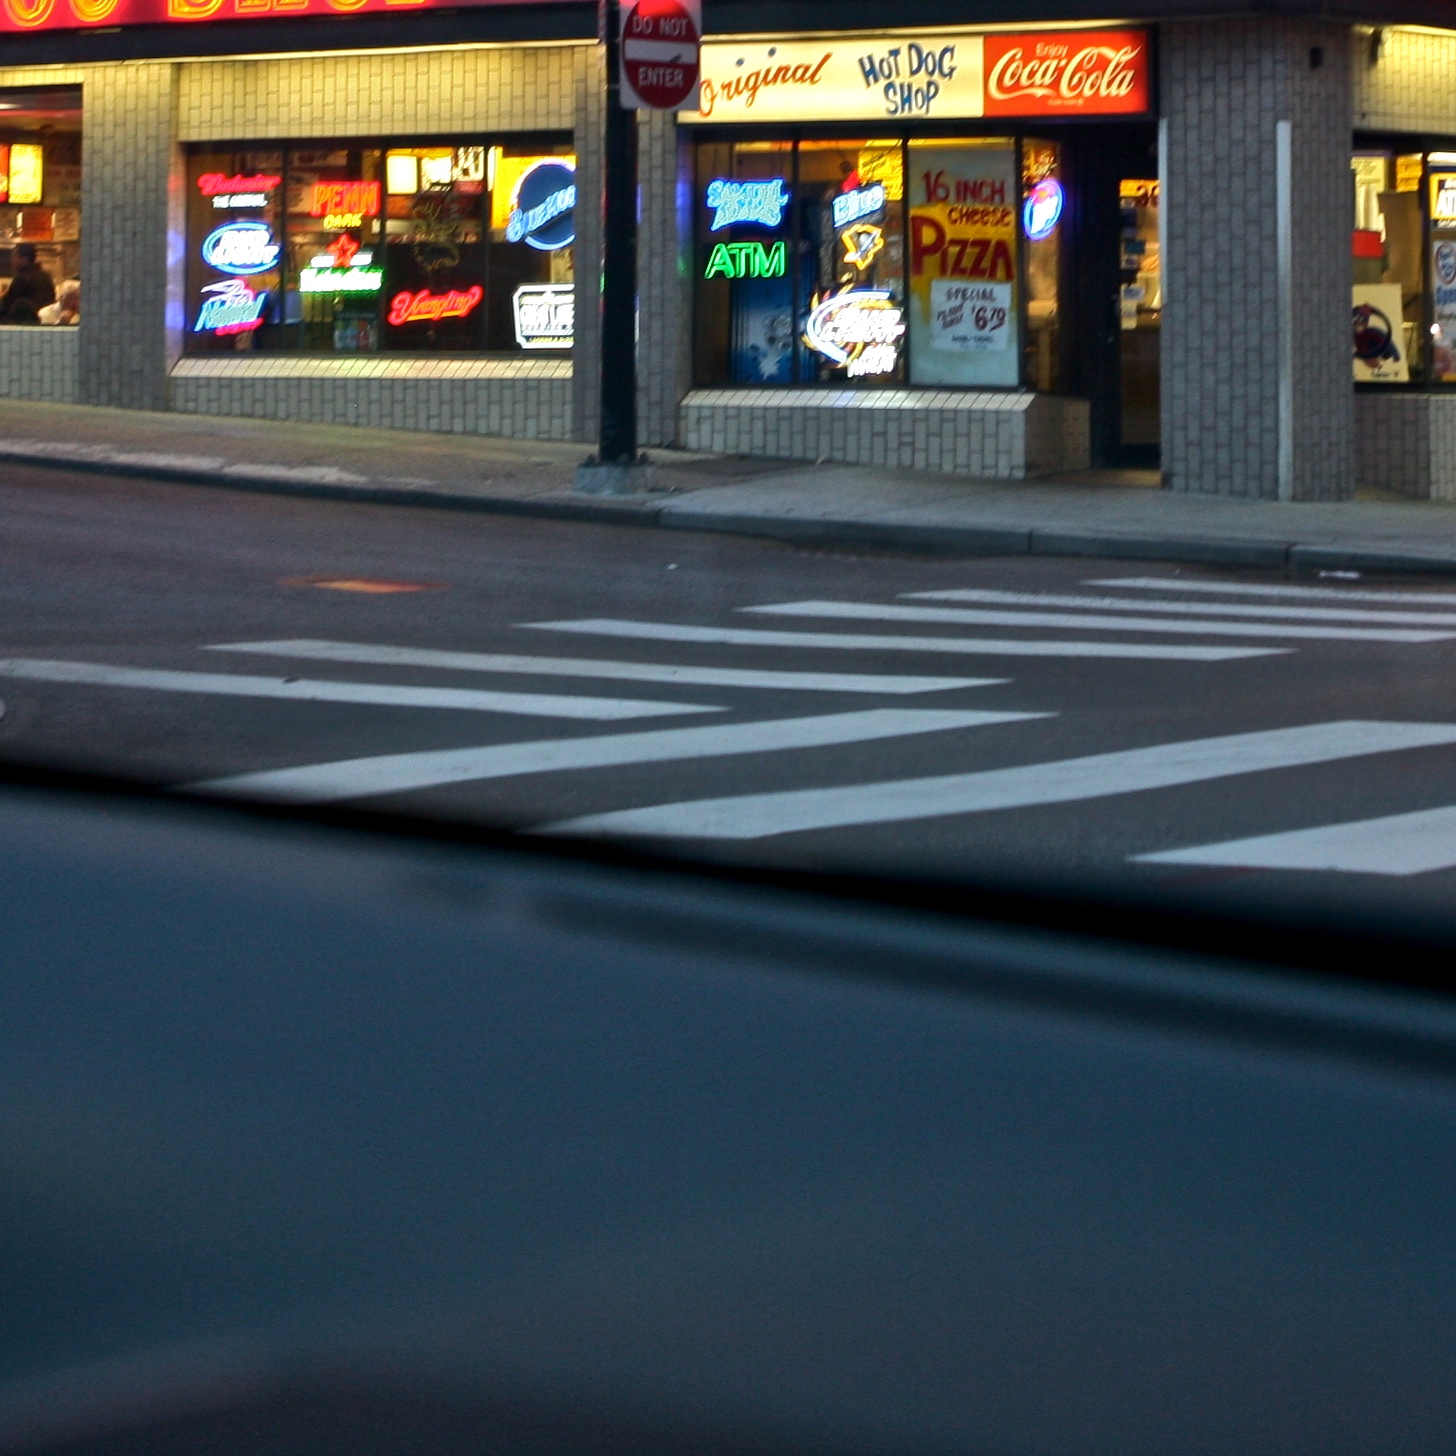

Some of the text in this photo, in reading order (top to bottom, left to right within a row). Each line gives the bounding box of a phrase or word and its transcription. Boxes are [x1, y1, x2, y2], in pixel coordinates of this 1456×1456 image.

[632, 15, 688, 36] DO NOT
[1036, 42, 1068, 60] Enjoy
[638, 66, 684, 88] ENTER
[700, 42, 957, 116] Original HOT DOG
[987, 45, 1142, 100] Coca-Cola
[884, 79, 940, 116] SHOP
[310, 182, 381, 216] PENN
[922, 169, 1006, 204] 16 INCH
[704, 240, 786, 280] ATM
[910, 215, 1015, 281] PIZZA
[388, 285, 484, 326] Yuengling
[946, 287, 997, 303] SPECIAL
